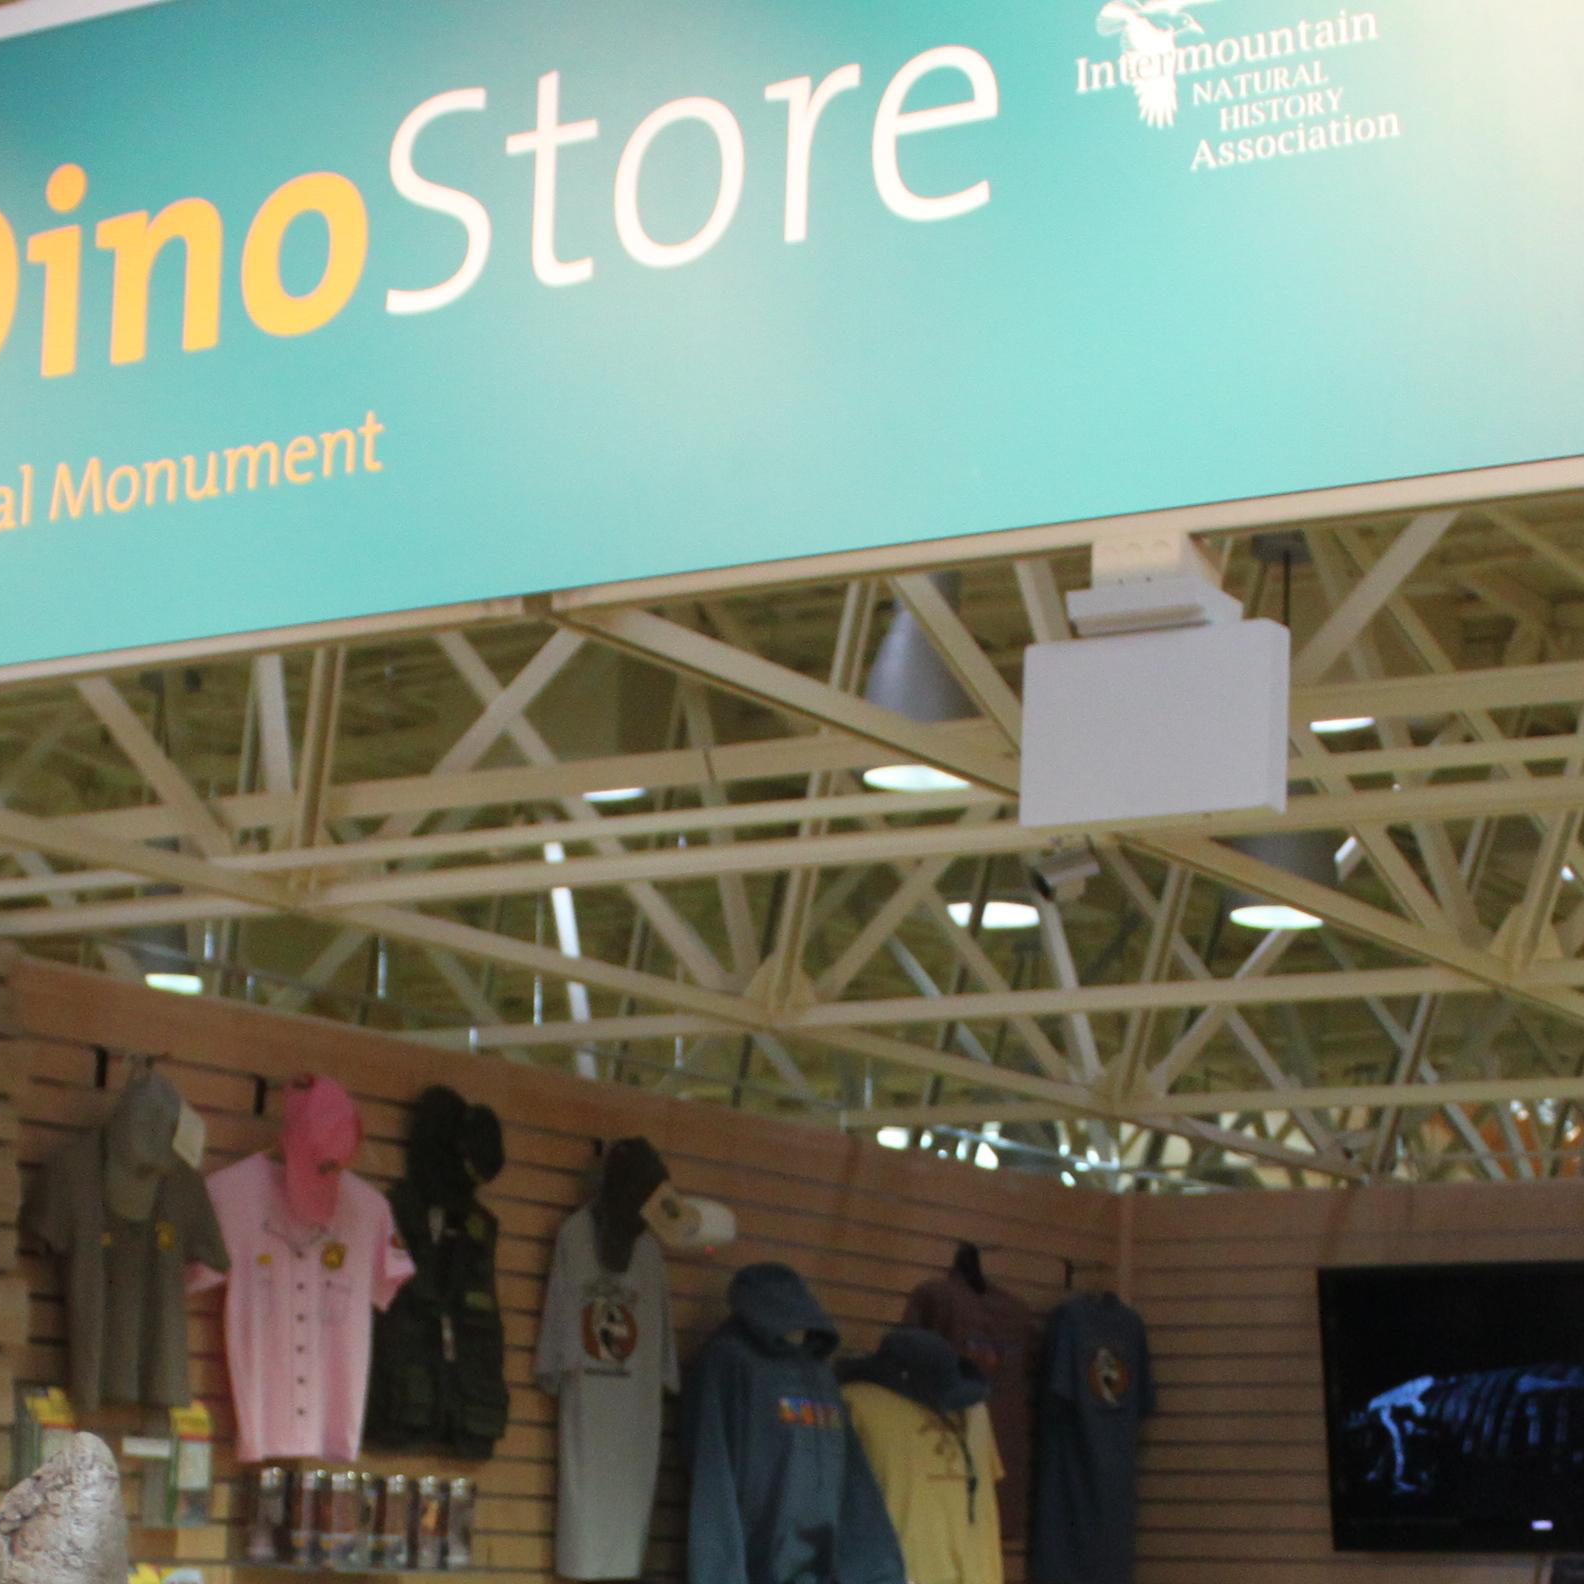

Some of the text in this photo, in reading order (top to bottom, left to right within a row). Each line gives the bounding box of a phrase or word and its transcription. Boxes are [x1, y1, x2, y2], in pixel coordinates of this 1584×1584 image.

[1074, 9, 1380, 95] Intermountain
[1191, 60, 1330, 106] NATURAL
[1219, 87, 1345, 132] HISTORY
[1189, 110, 1402, 172] Association
[46, 410, 385, 522] Monument
